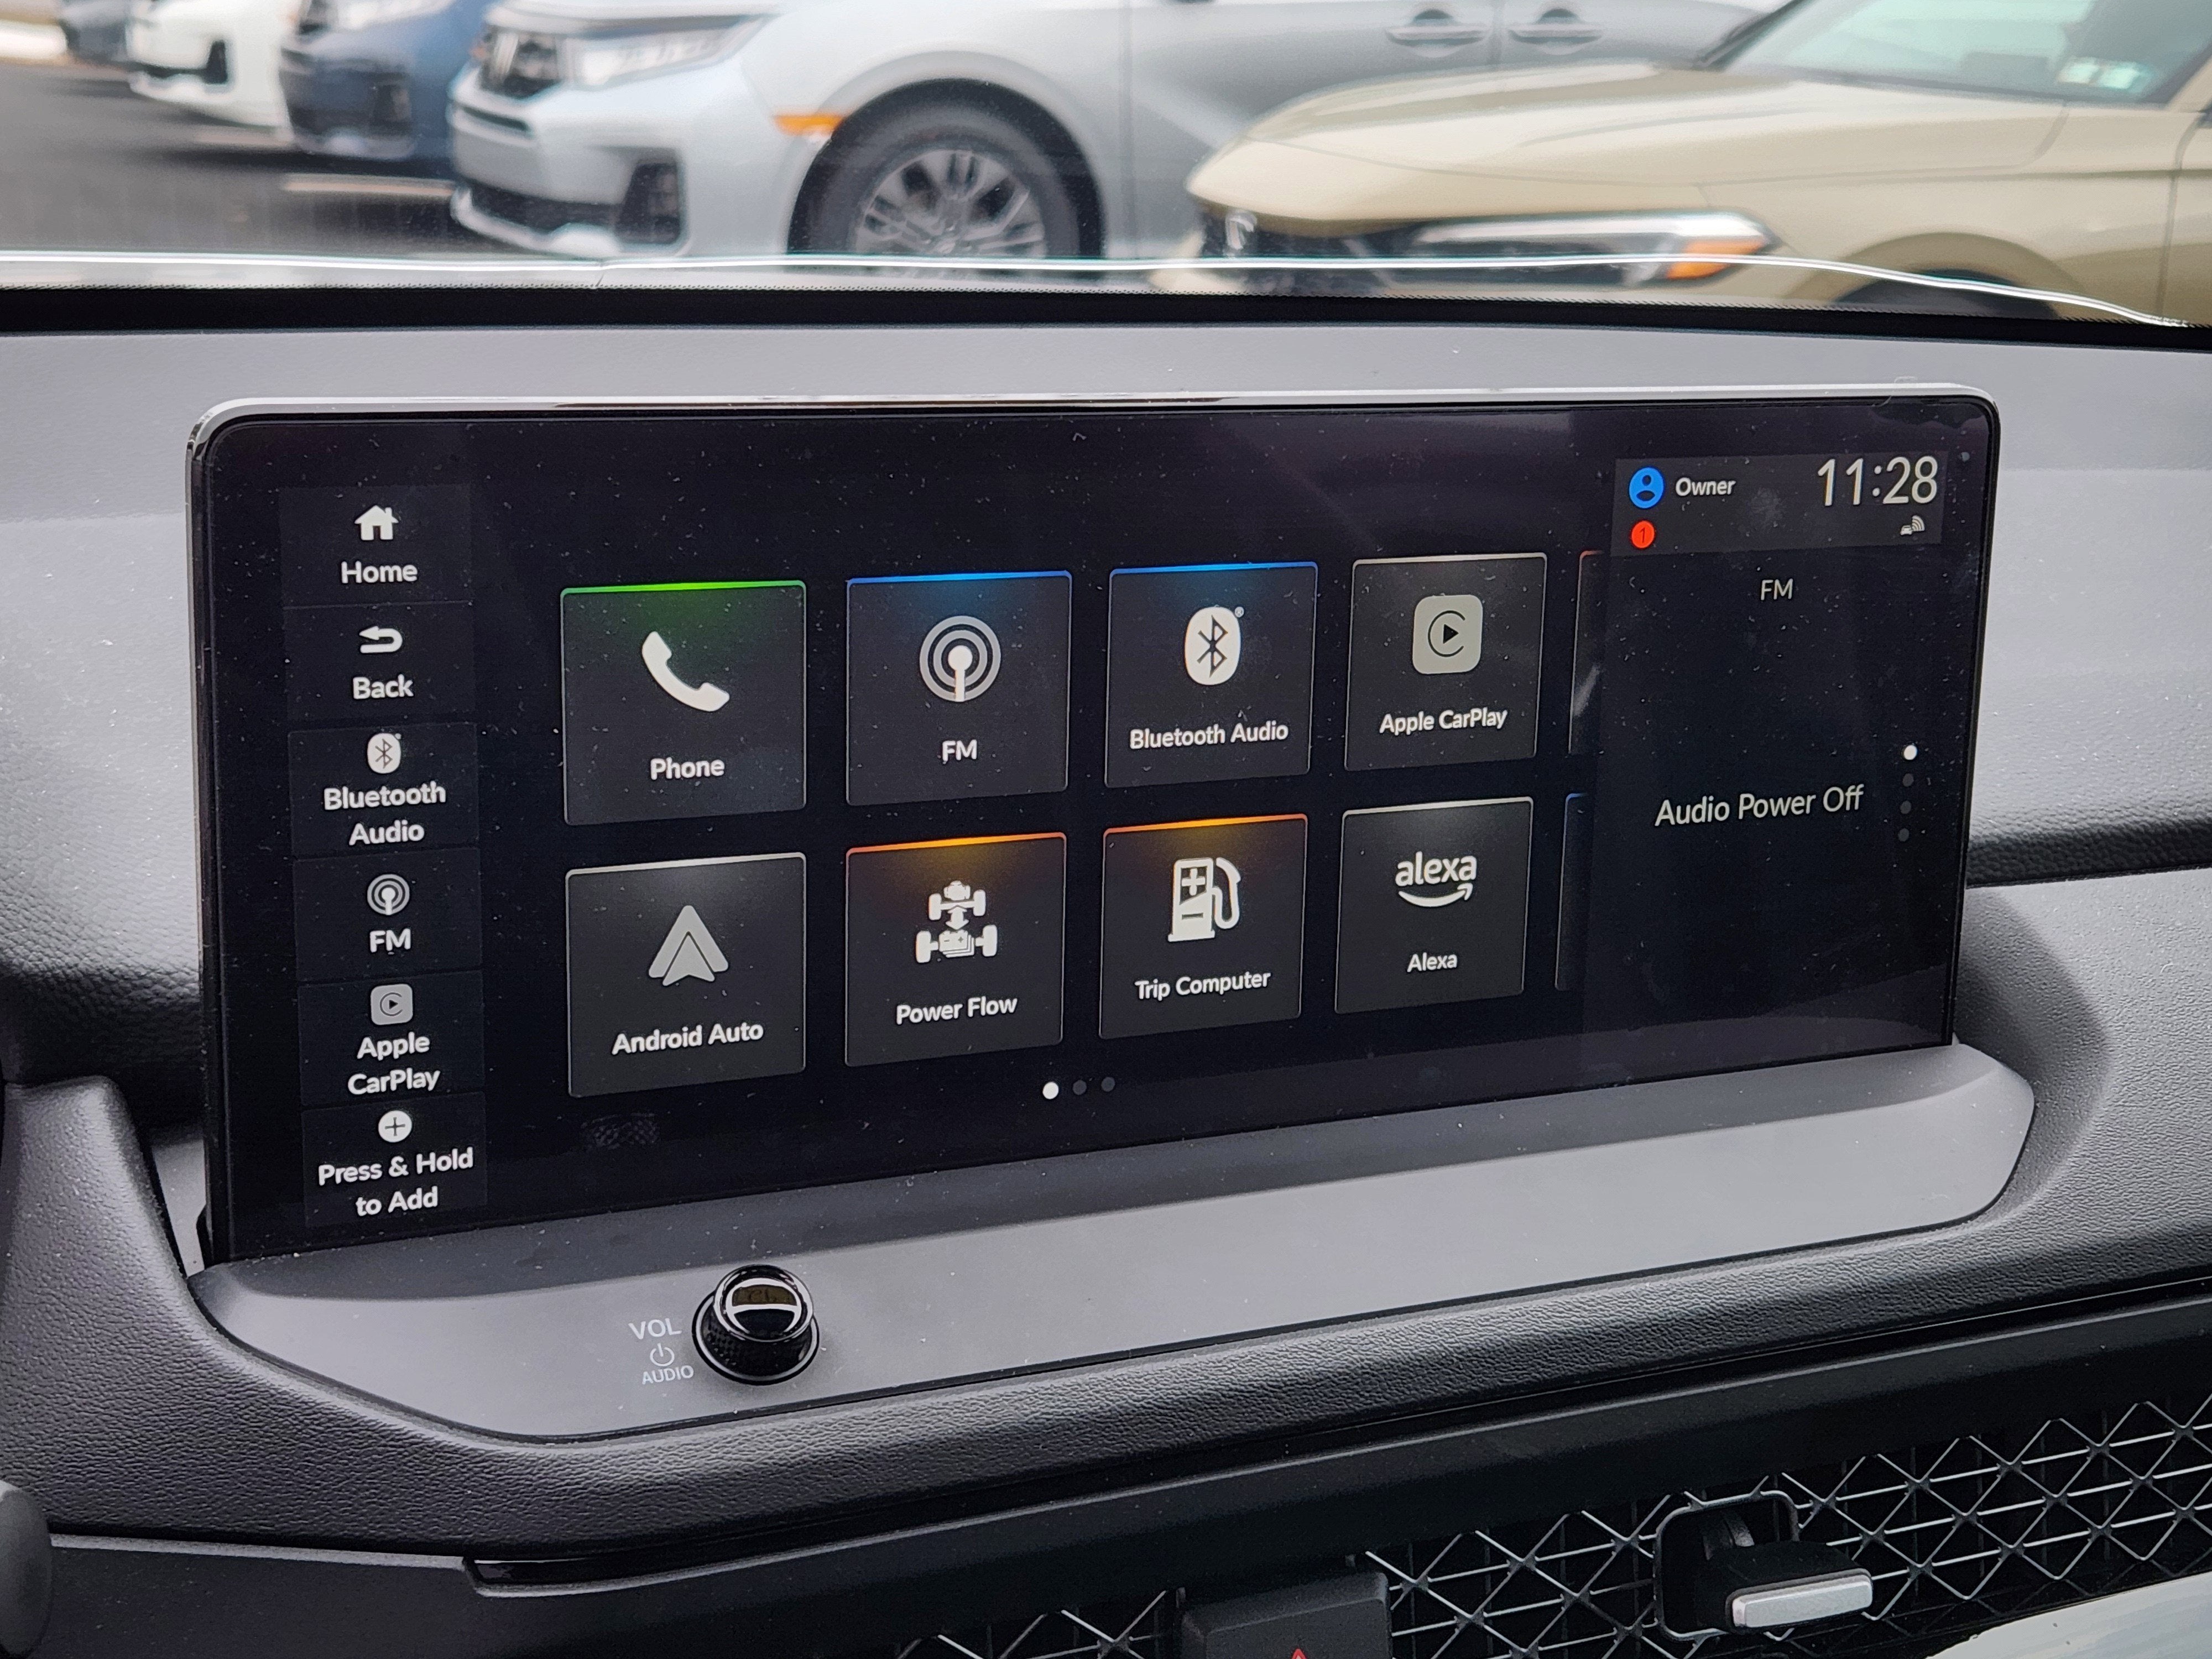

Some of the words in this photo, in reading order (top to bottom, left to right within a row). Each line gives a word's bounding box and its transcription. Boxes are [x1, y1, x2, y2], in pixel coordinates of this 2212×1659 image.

[1675, 477, 1736, 497] Owner
[1817, 455, 1938, 507] 11:28
[341, 560, 419, 584] Home
[1760, 578, 1794, 601] FM
[352, 673, 414, 700] Back
[1129, 723, 1226, 750] Bluetooth
[1229, 719, 1289, 743] Audio
[1379, 710, 1435, 737] Apple
[1438, 706, 1509, 729] CarPlay
[942, 739, 978, 761] FM
[650, 756, 726, 781] Phone
[324, 780, 447, 811] Bluetooth
[1654, 795, 1730, 827] Audio
[1738, 792, 1817, 820] Power
[1822, 783, 1865, 812] Off
[348, 818, 425, 846] Audio
[1394, 851, 1478, 888] alexa
[369, 927, 411, 953] FM
[1406, 951, 1458, 973] Alexa
[1134, 978, 1171, 1001] Trip
[1175, 971, 1272, 996] Computer
[896, 1003, 964, 1025] Power
[967, 995, 1018, 1018] Flow
[356, 1031, 431, 1062] Apple
[611, 1024, 703, 1056] Android
[707, 1021, 764, 1045] Auto
[347, 1067, 441, 1095] CarPlay
[317, 1162, 383, 1186] Press
[388, 1155, 410, 1178] &
[415, 1146, 474, 1175] Hold
[354, 1196, 383, 1217] to
[387, 1185, 439, 1213] Add
[627, 1317, 682, 1340] VOL
[641, 1364, 695, 1385] AUDIO
